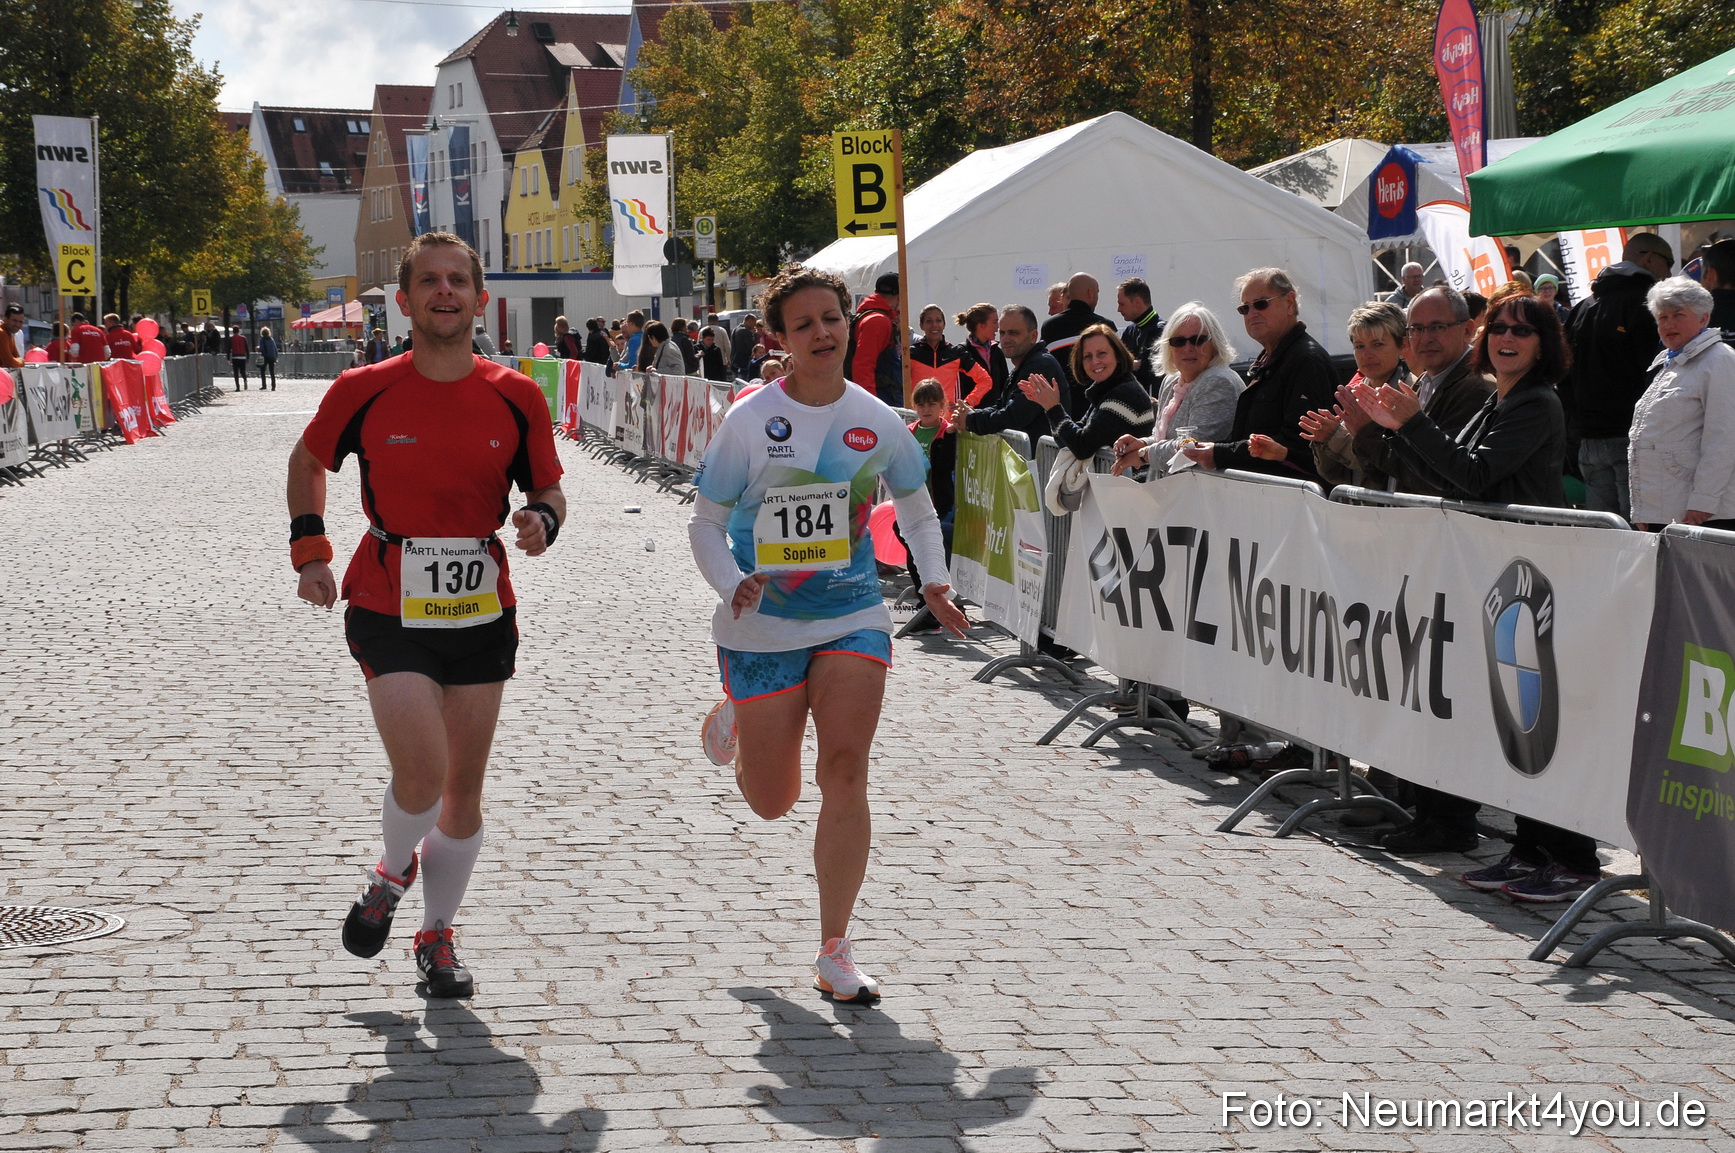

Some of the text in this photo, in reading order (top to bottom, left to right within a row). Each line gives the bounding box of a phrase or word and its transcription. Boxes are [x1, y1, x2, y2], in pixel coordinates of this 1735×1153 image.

[841, 135, 893, 155] Block
[852, 163, 887, 214] B
[1378, 176, 1404, 207] Hervis
[701, 222, 709, 231] H
[62, 246, 90, 256] Block
[67, 259, 85, 285] C
[197, 297, 207, 311] D
[848, 433, 874, 446] Hervis
[767, 445, 795, 453] PARTL
[761, 491, 833, 504] ARTL Neumarkt
[774, 504, 834, 539] 184
[404, 547, 438, 556] PARTL
[783, 546, 827, 563] Sophie
[424, 560, 485, 594] 130
[425, 602, 480, 616] Christian
[1484, 564, 1553, 638] BMW
[1088, 527, 1455, 719] PARTL Neumarkt
[1680, 659, 1735, 758] B
